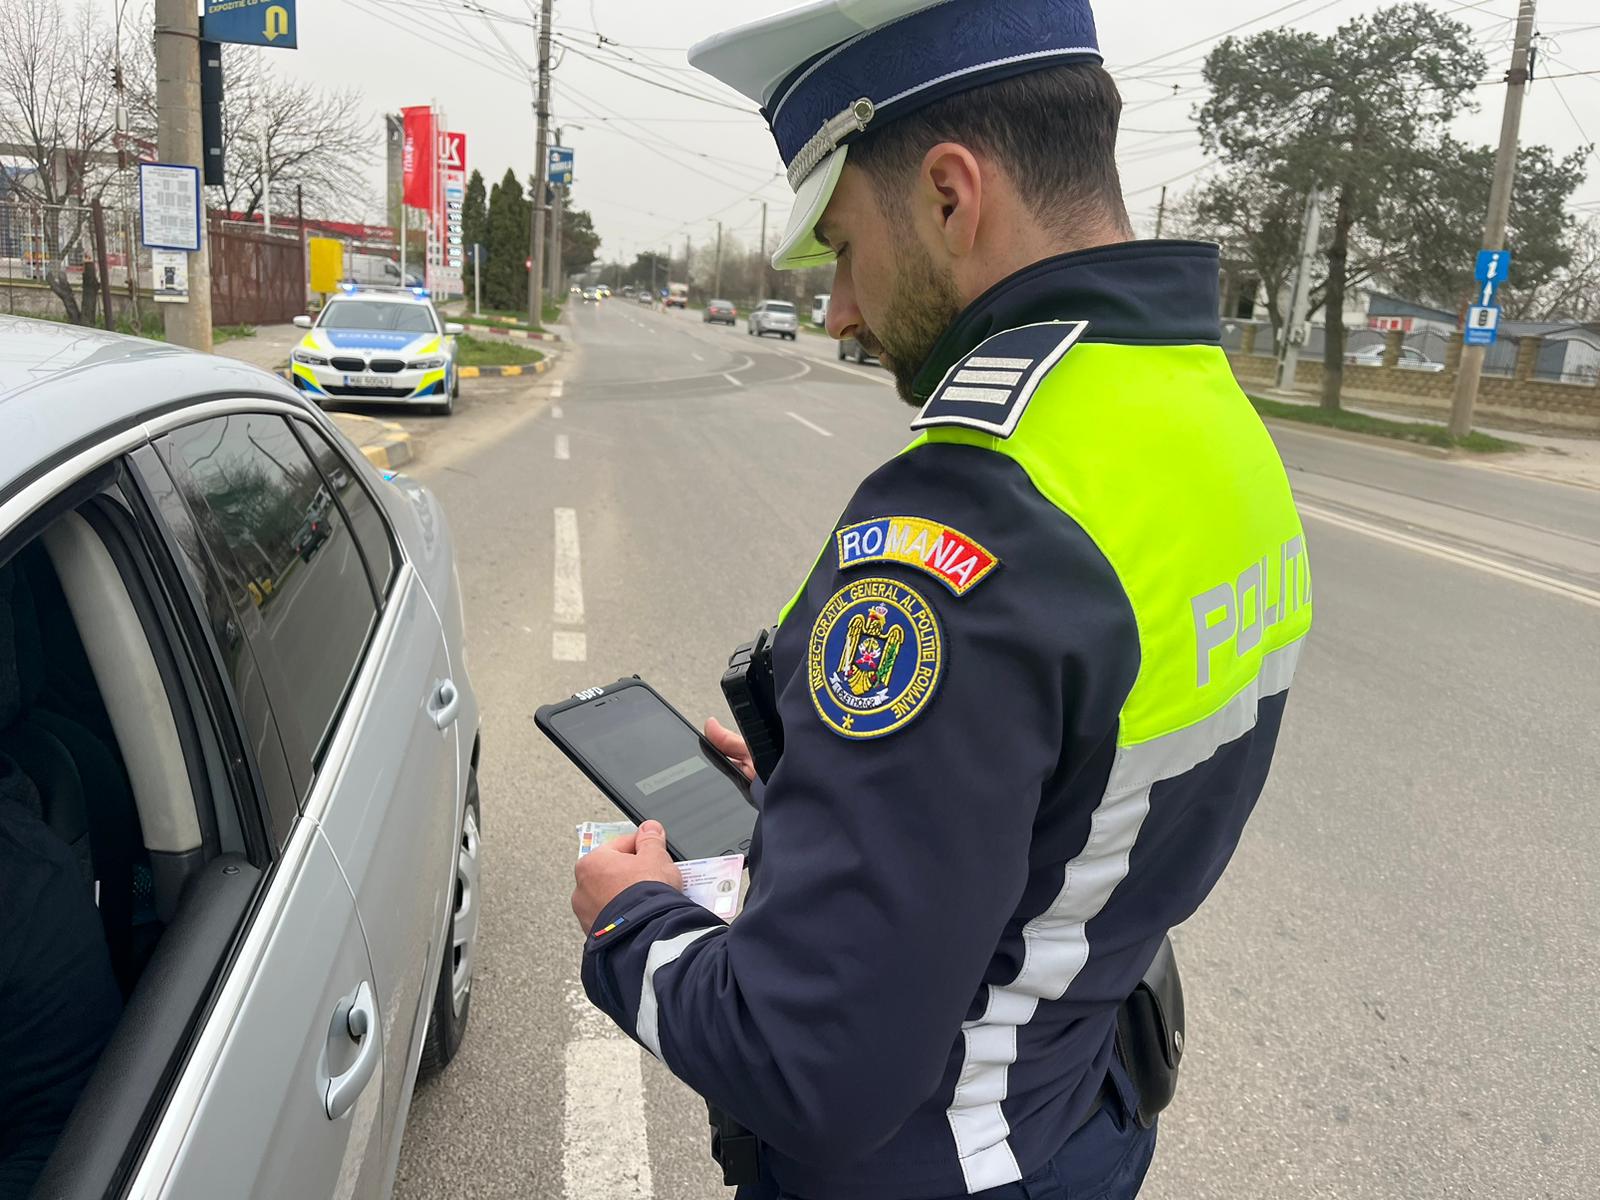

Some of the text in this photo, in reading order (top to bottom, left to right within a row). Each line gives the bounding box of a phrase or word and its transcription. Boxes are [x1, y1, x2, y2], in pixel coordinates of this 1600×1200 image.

[842, 526, 979, 587] ROMANIA
[850, 583, 899, 601] GENERAL
[900, 594, 915, 612] AL
[1191, 534, 1312, 689] POLITI
[812, 596, 849, 691] INSPECTORATUL
[890, 665, 933, 720] ROMANE
